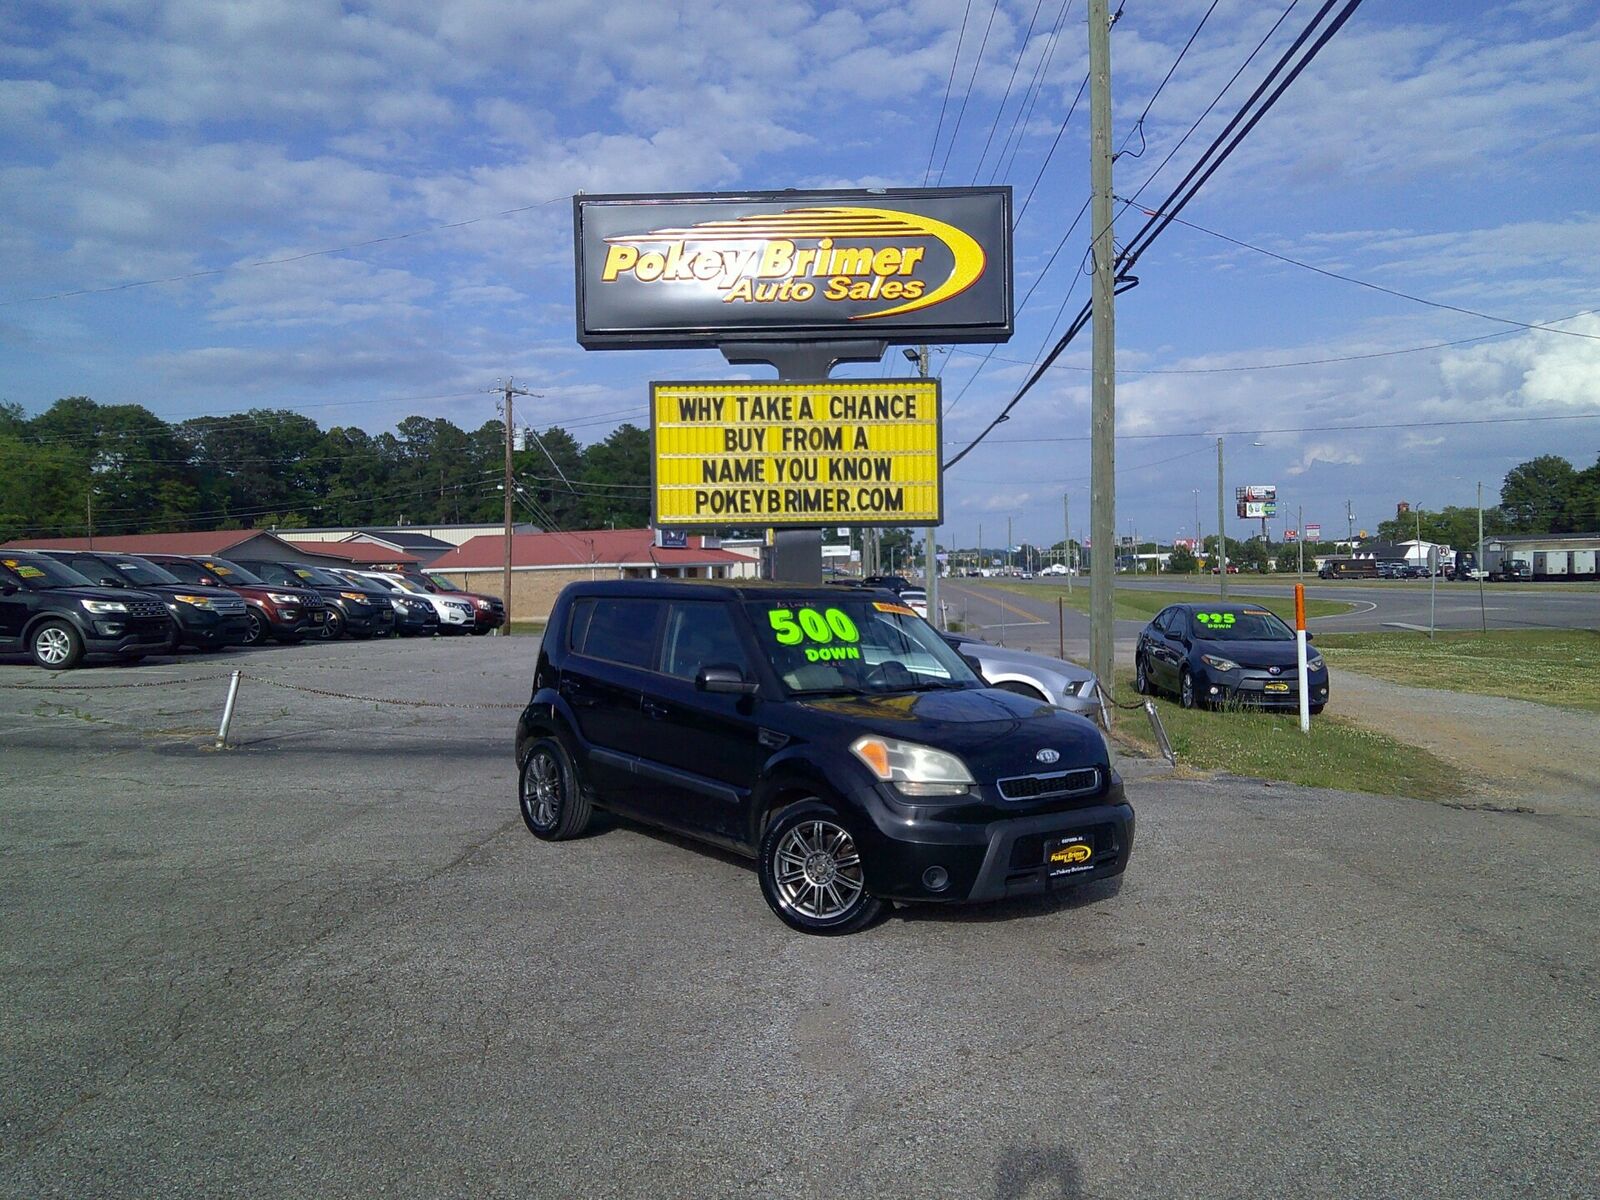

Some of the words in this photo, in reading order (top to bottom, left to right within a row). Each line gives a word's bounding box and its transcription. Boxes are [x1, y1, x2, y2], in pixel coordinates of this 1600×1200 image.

[602, 240, 755, 288] Pokey
[754, 237, 925, 278] Brimer
[724, 277, 815, 303] Auto
[824, 276, 925, 301] Sales
[679, 397, 725, 421] WHY
[736, 396, 793, 421] TAKE
[798, 395, 814, 420] A
[829, 395, 917, 419] CHANCE
[724, 428, 766, 452] BUY
[782, 427, 843, 451] FROM
[853, 426, 869, 450] A
[702, 459, 765, 483] NAME
[774, 458, 818, 482] YOU
[829, 457, 892, 481] KNOW
[695, 488, 904, 514] POKEYBRIMER.COM
[768, 608, 859, 645] 500
[1196, 613, 1236, 624] 995
[805, 647, 860, 662] DOWN
